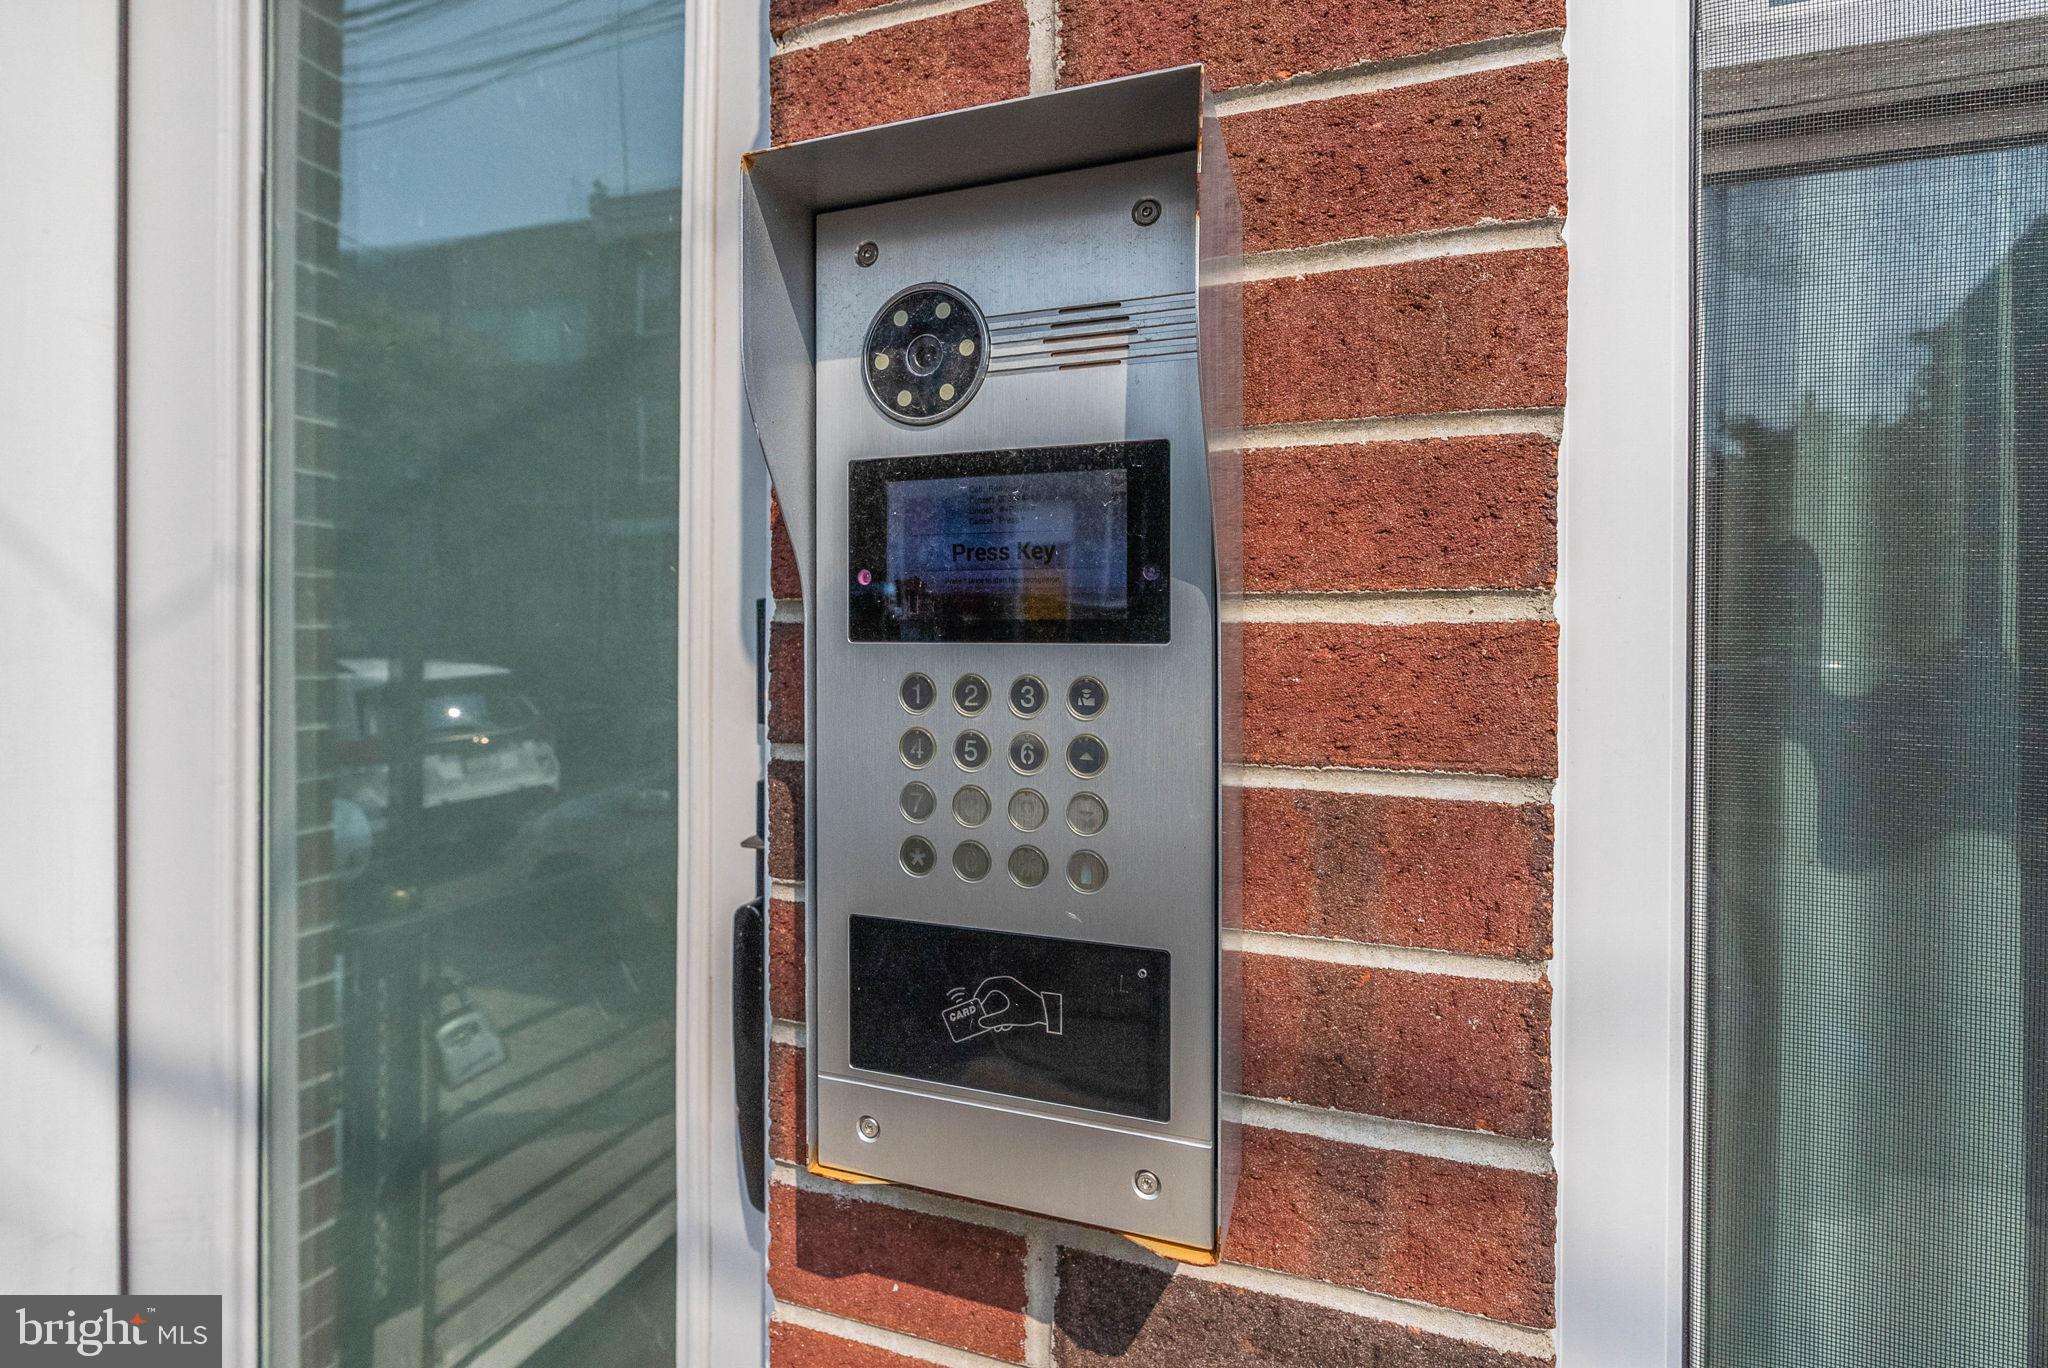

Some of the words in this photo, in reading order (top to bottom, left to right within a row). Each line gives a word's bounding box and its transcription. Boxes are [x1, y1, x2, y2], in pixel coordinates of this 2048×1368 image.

[952, 543, 1010, 561] Press
[1017, 541, 1056, 565] Key
[912, 683, 921, 704] 1
[964, 684, 979, 706] 2
[1020, 685, 1035, 708] 3
[910, 738, 924, 759] 4
[964, 740, 978, 761] 5
[1020, 742, 1035, 765] 6
[911, 793, 924, 813] 7
[950, 1005, 977, 1022] CARD
